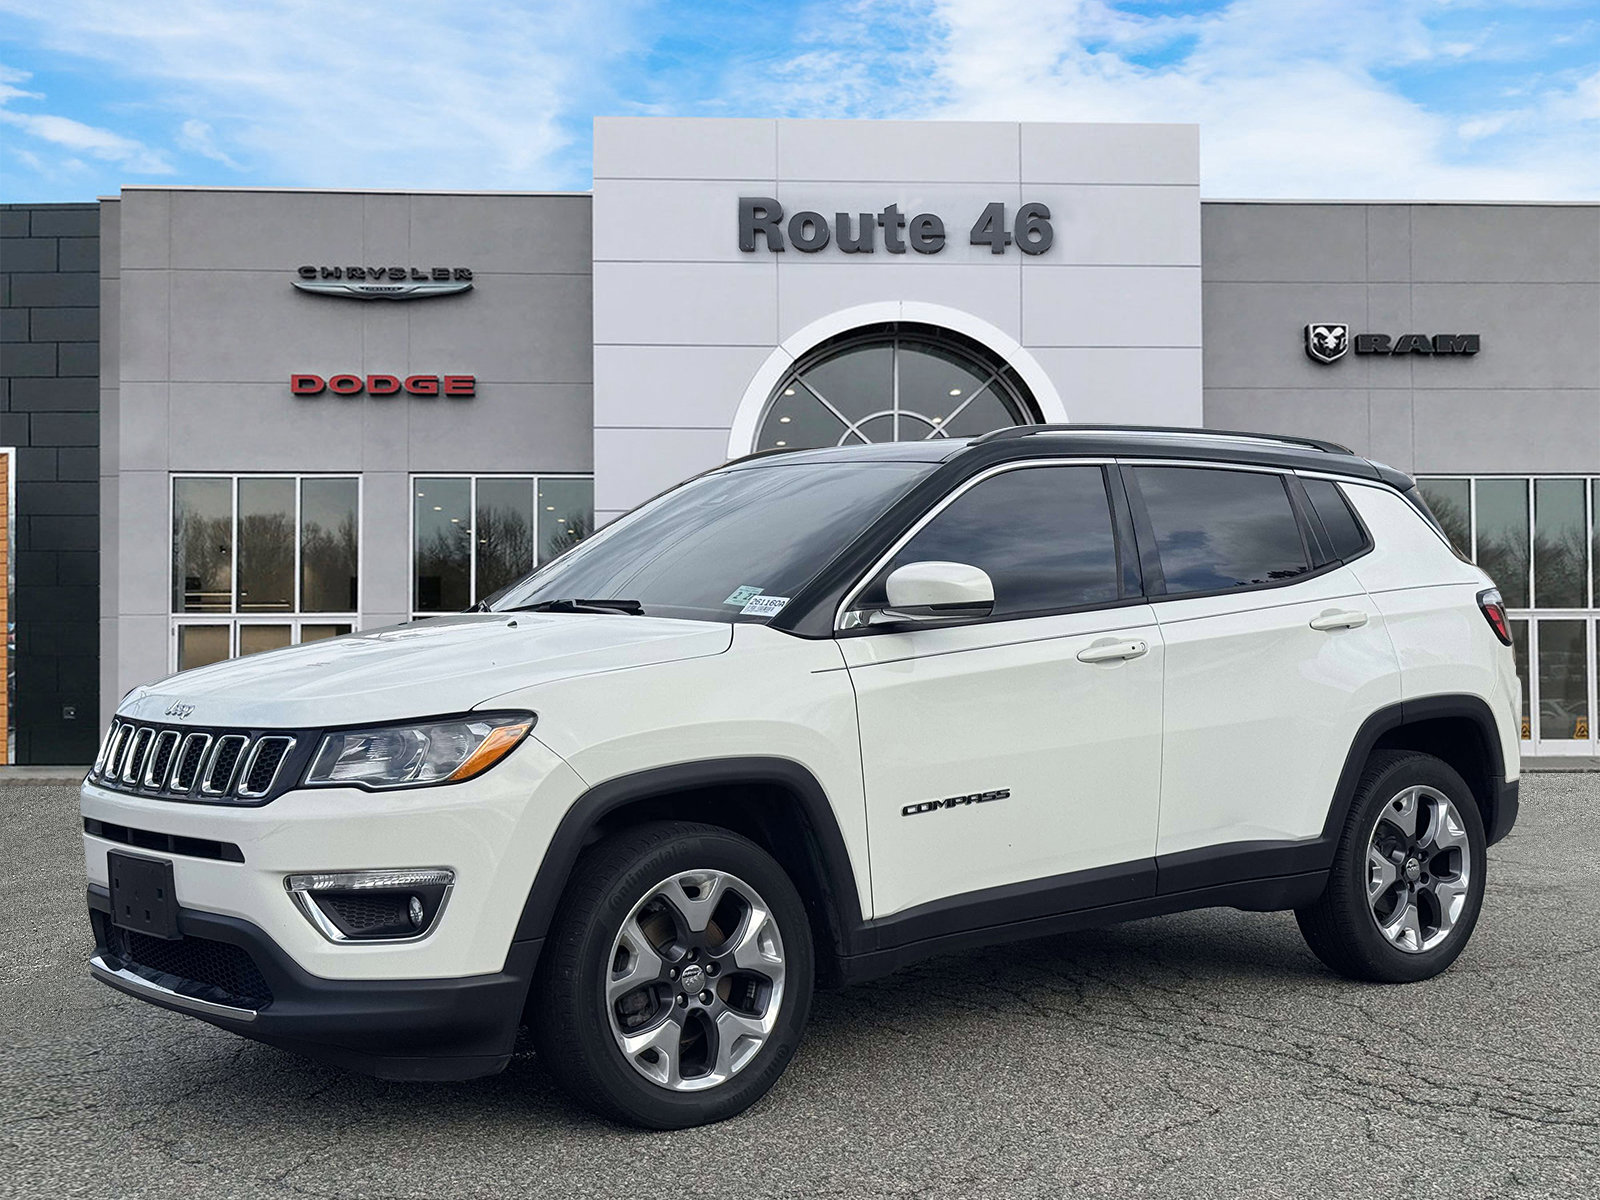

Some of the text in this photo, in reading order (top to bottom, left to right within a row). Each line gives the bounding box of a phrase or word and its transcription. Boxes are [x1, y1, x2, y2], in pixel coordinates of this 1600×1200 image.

[739, 197, 1054, 255] Route 46
[298, 265, 473, 280] CHRYSLER
[1355, 334, 1480, 355] RAM
[291, 374, 476, 396] DODGE
[165, 700, 195, 720] Jeep
[902, 788, 1010, 816] COMPASS
